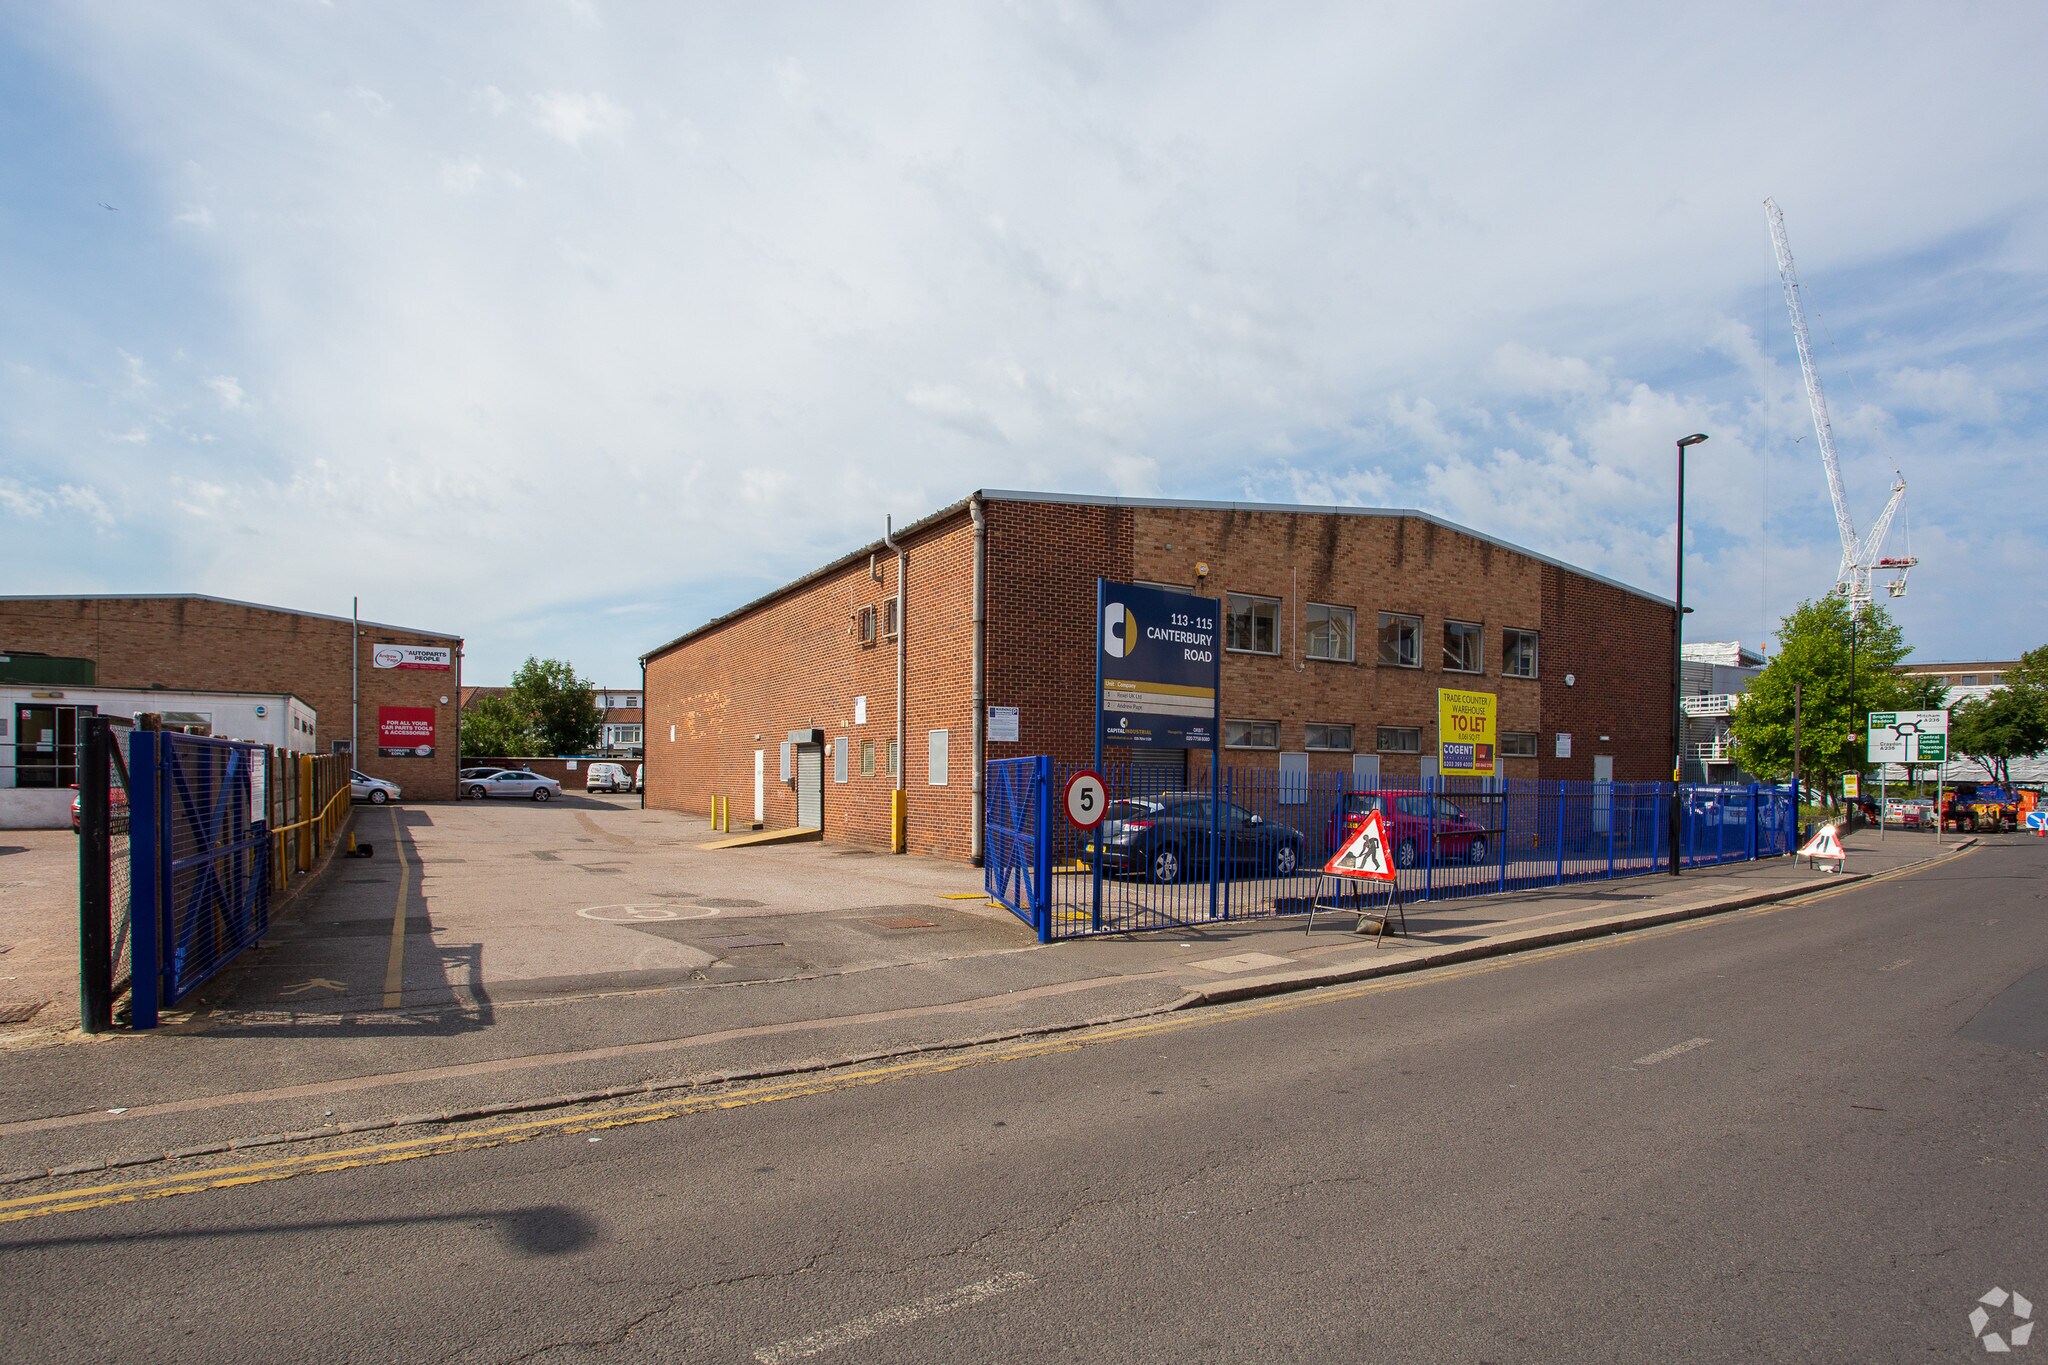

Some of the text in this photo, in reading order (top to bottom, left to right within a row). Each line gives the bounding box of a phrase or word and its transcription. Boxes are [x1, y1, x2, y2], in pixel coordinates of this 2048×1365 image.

[1171, 613, 1188, 626] 113
[1196, 617, 1212, 630] 115
[1147, 626, 1212, 646] CANTERBURY
[1184, 648, 1212, 662] ROAD
[1444, 693, 1461, 703] TRADE
[1462, 696, 1487, 705] COUNTER
[1452, 705, 1485, 715] WAREHOUSE
[1451, 715, 1486, 732] TO LET
[1444, 744, 1473, 755] COGENT
[1081, 788, 1093, 812] 5
[624, 905, 678, 919] 5
